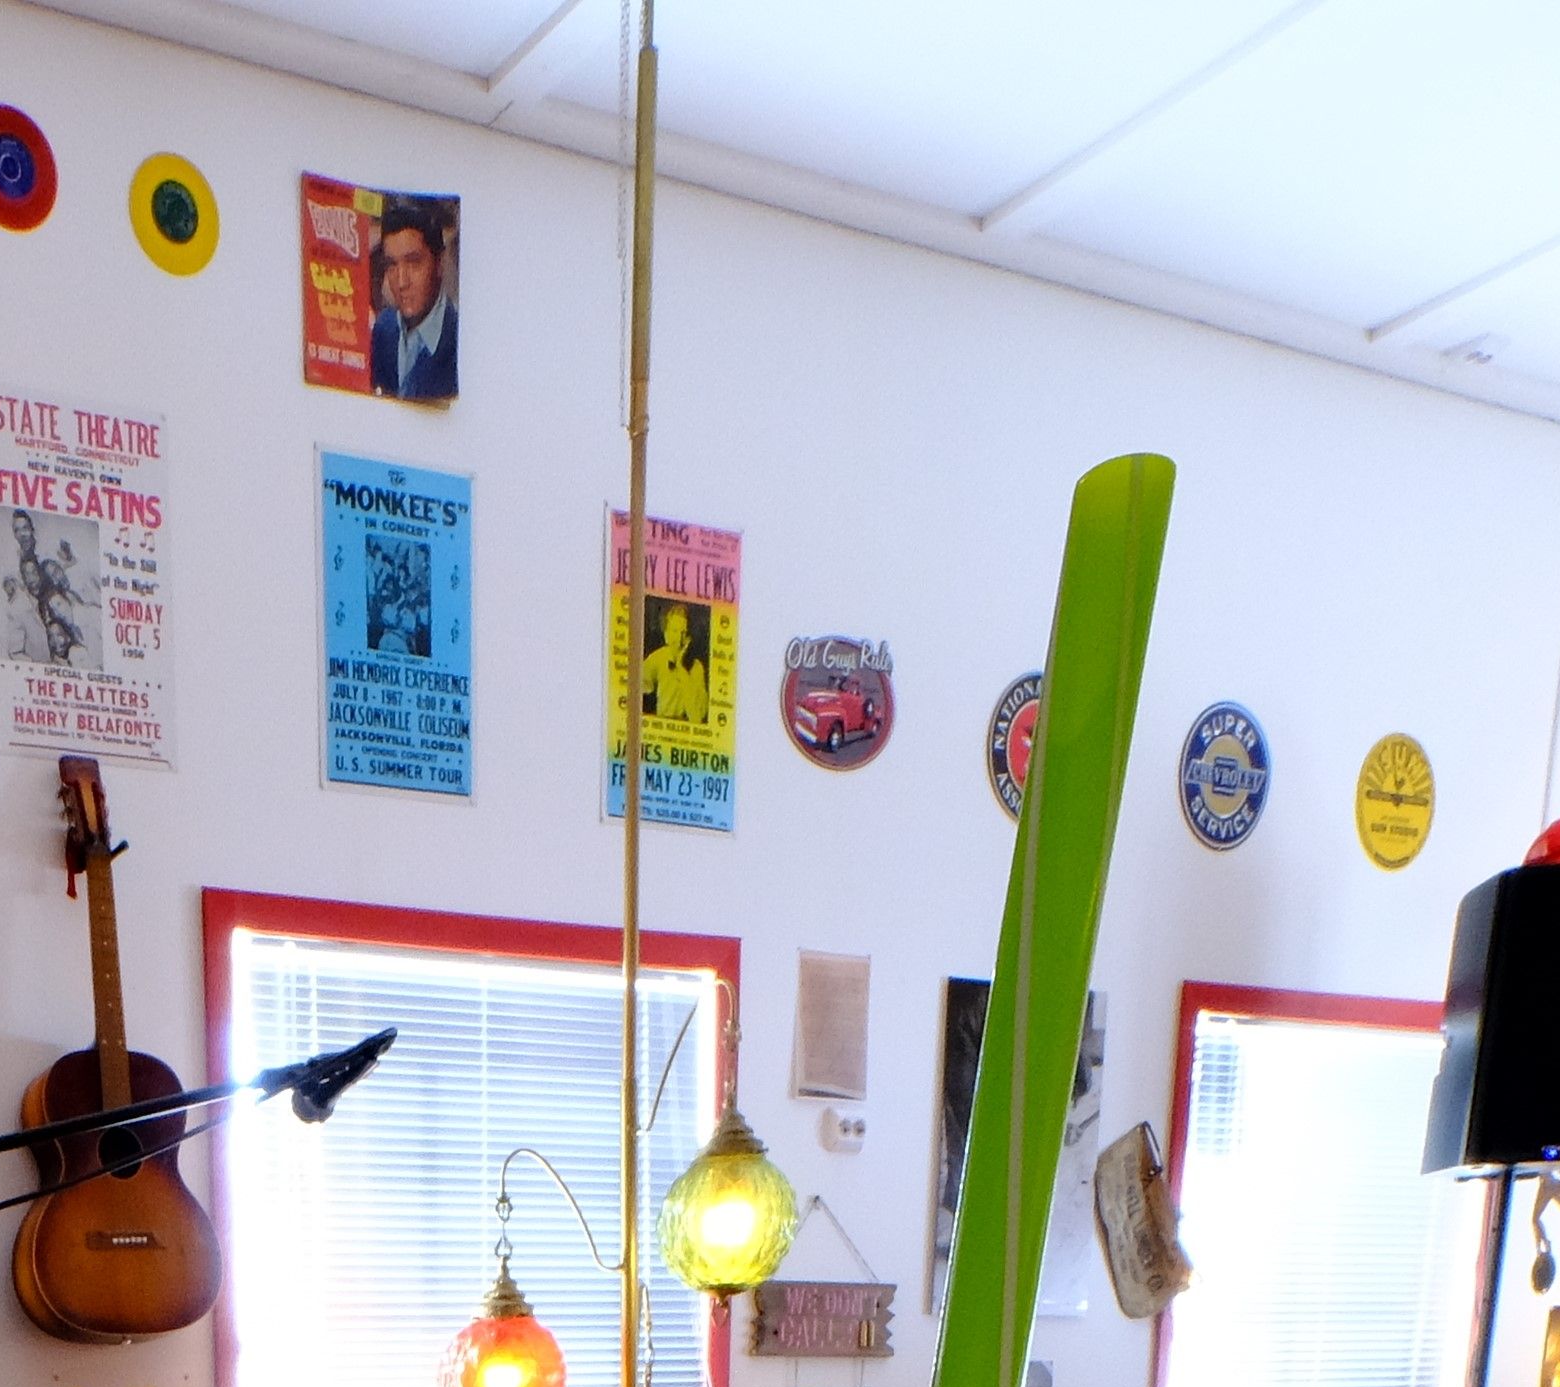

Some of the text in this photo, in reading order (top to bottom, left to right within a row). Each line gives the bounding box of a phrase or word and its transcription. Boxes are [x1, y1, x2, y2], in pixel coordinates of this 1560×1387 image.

[74, 410, 160, 458] THEATRE
[66, 481, 162, 529] SATINS
[382, 520, 429, 538] CONCERT
[666, 557, 735, 603] LEE LEWIS
[109, 597, 163, 625] SUNDAY
[115, 624, 147, 648] OCT.
[787, 638, 817, 670] Old
[823, 640, 857, 676] Guys
[25, 678, 57, 697] THE
[63, 682, 149, 709] PLATTERS
[333, 683, 358, 700] JULY
[352, 660, 400, 686] HENDRIX
[405, 667, 469, 696] EXPERIENCE
[14, 706, 69, 728] HARRY
[77, 714, 161, 740] BELAFONTE
[329, 702, 470, 739] JACKSONVILLE COLISEUM
[1202, 714, 1256, 750] SUPER
[421, 739, 463, 753] FLORIDA
[671, 747, 729, 773] BURTON
[370, 760, 462, 785] SUMMER TOUR
[645, 767, 672, 793] MAY
[1192, 762, 1263, 792] CHEVROLET
[1191, 796, 1254, 839] SERVICE
